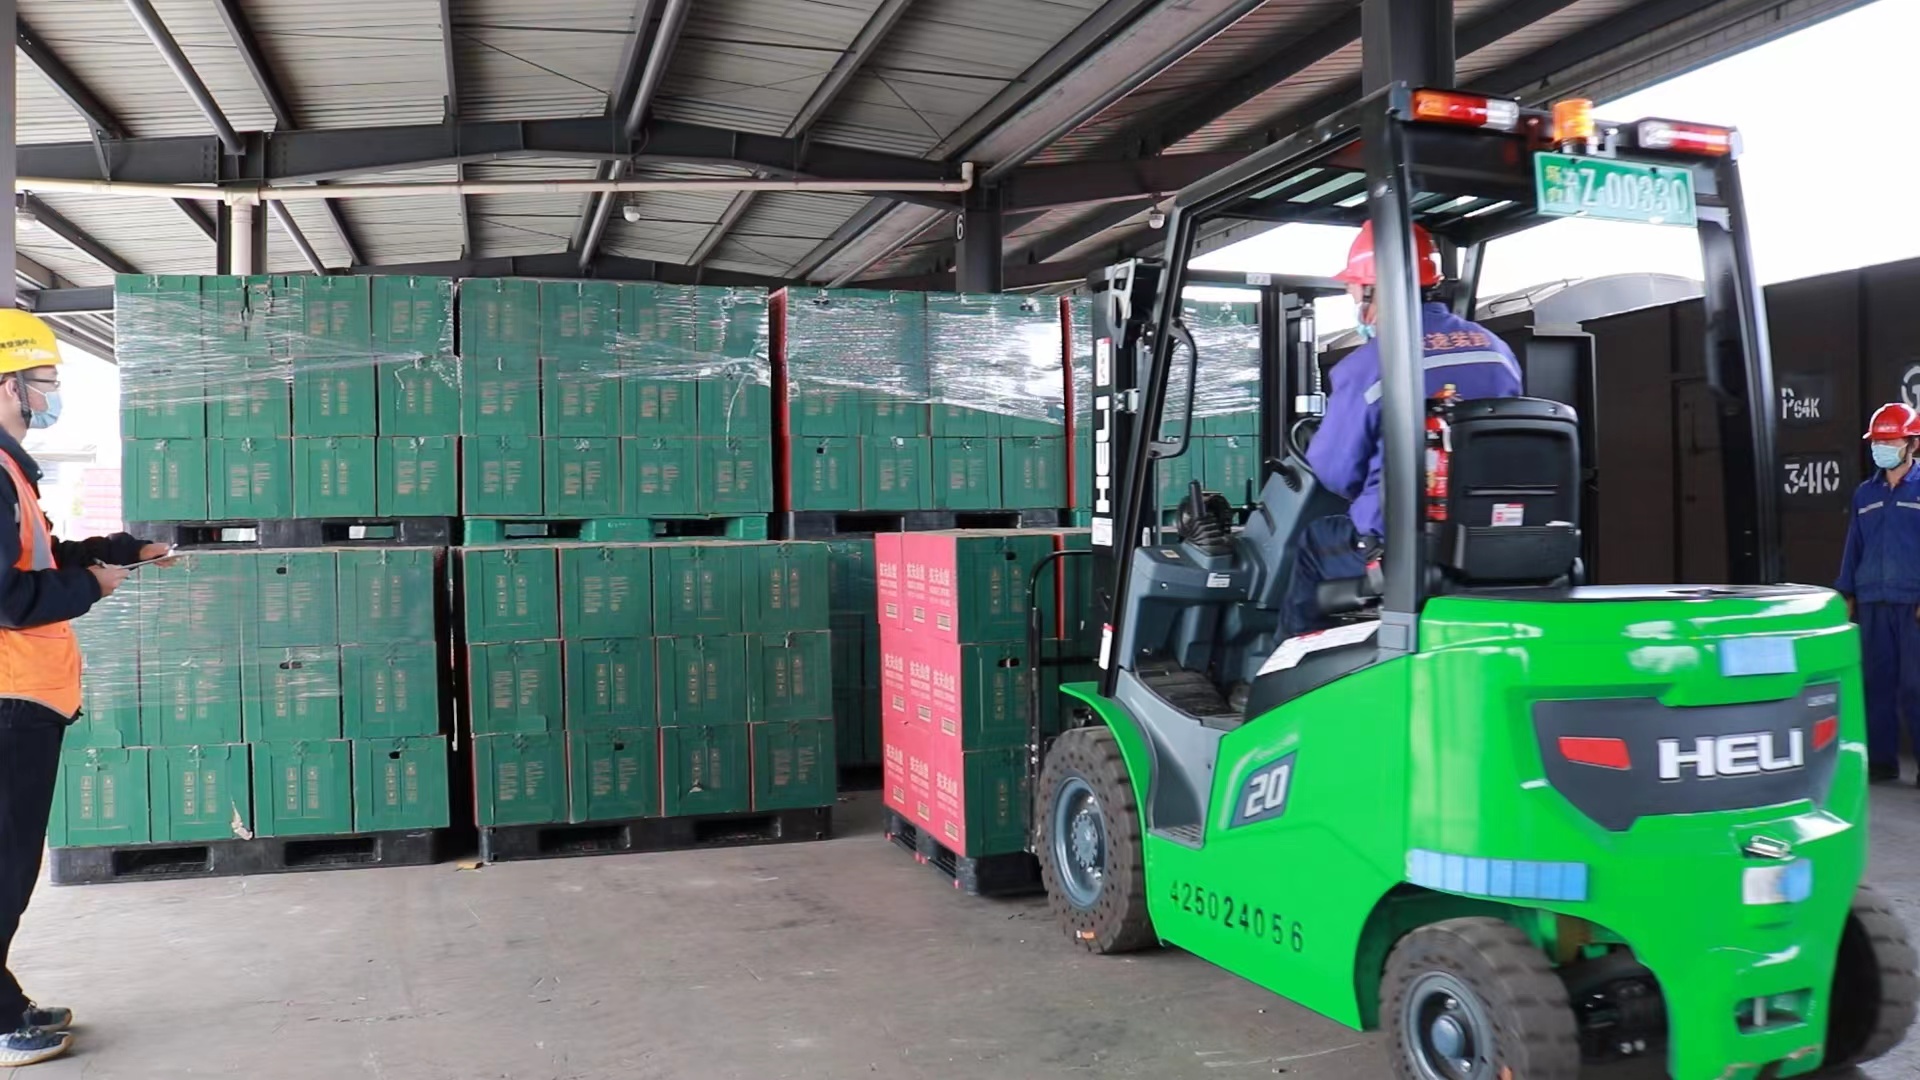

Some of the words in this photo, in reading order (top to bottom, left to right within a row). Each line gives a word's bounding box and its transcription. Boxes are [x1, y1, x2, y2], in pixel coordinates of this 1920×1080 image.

[956, 214, 964, 240] 6
[1781, 387, 1820, 419] P64K
[1095, 395, 1111, 513] HELI
[1784, 460, 1840, 494] 3410
[1657, 728, 1804, 783] HELI
[1243, 765, 1290, 818] 20
[1170, 880, 1303, 953] 425024056
